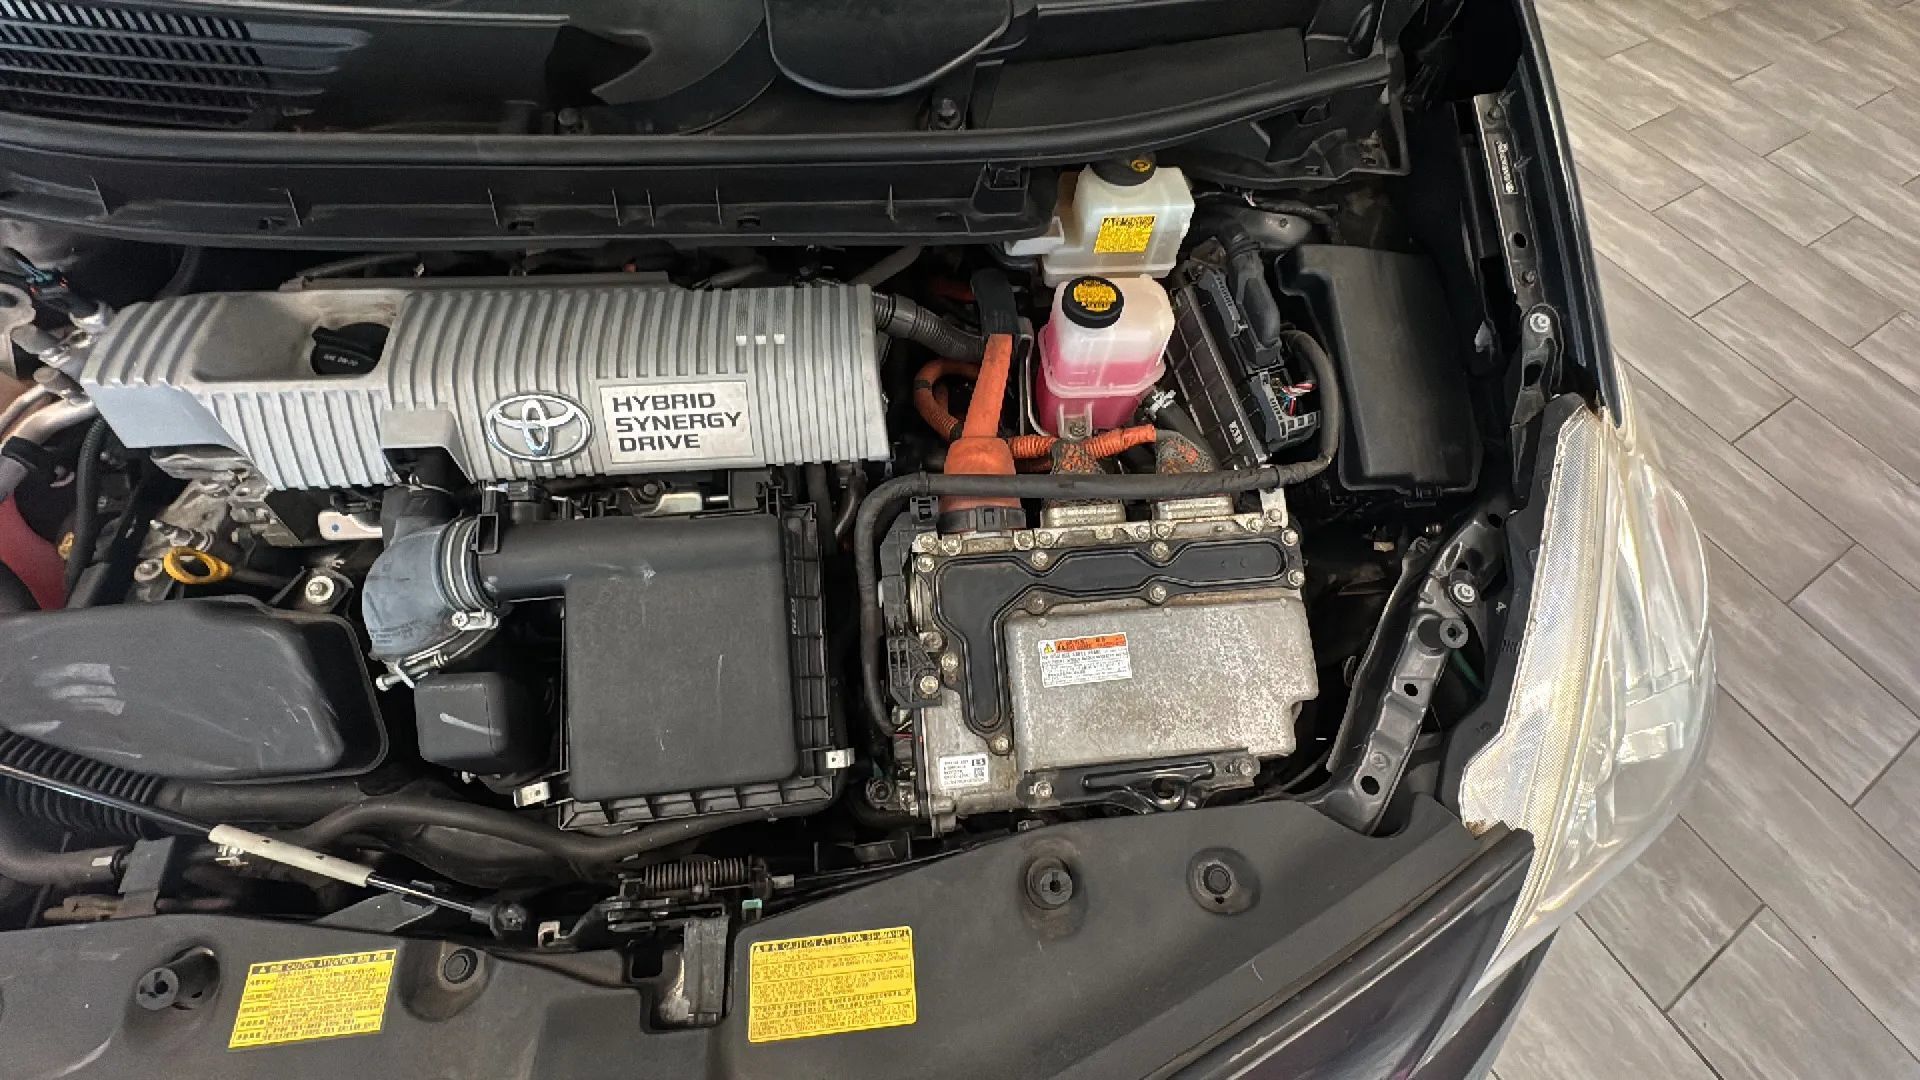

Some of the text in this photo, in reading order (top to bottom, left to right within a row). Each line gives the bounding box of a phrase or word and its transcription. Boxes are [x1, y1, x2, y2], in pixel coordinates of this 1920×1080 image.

[612, 392, 716, 413] HYBRID
[615, 411, 742, 433] SYNERGY
[618, 433, 701, 452] DRIVE
